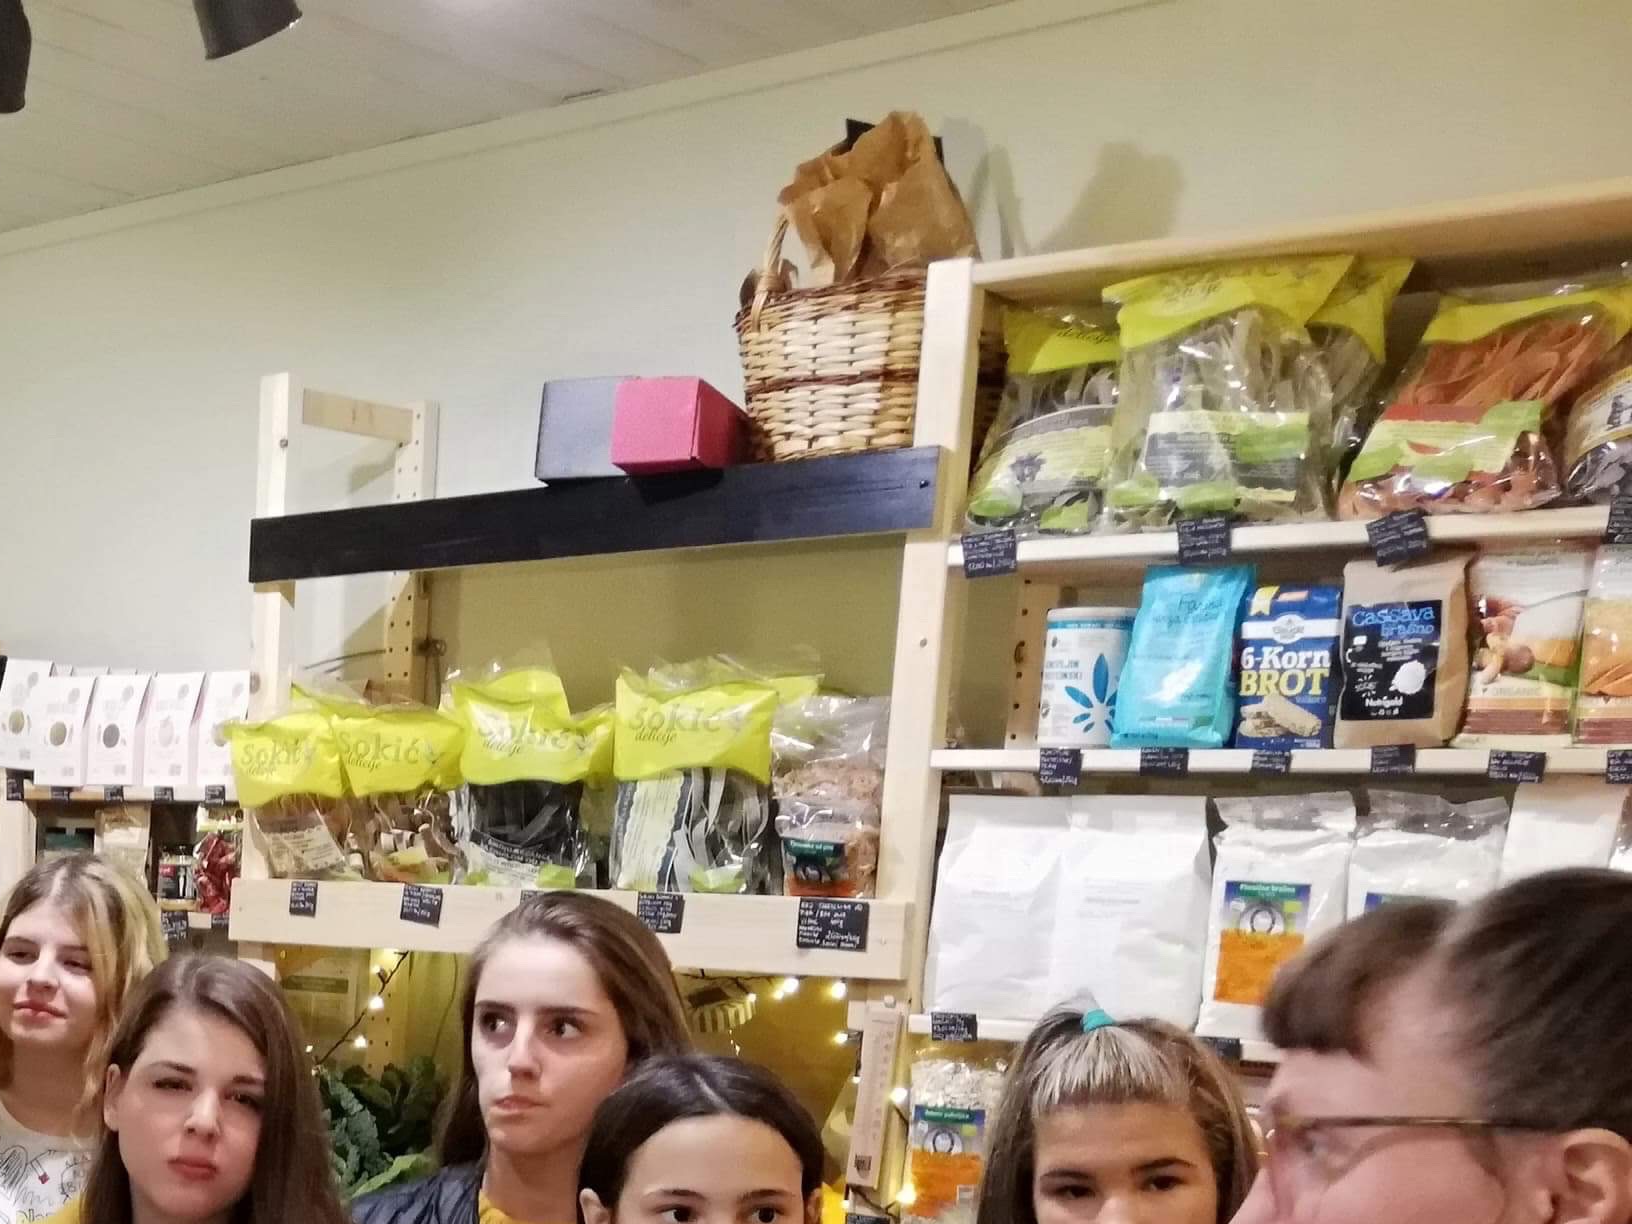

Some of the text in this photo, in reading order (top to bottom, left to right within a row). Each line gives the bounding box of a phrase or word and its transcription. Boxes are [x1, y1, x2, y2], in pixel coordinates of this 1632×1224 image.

[1352, 606, 1435, 627] Cassava
[1240, 646, 1332, 670] 6-Korn
[1239, 668, 1330, 697] BROT
[338, 731, 421, 765] Sokić
